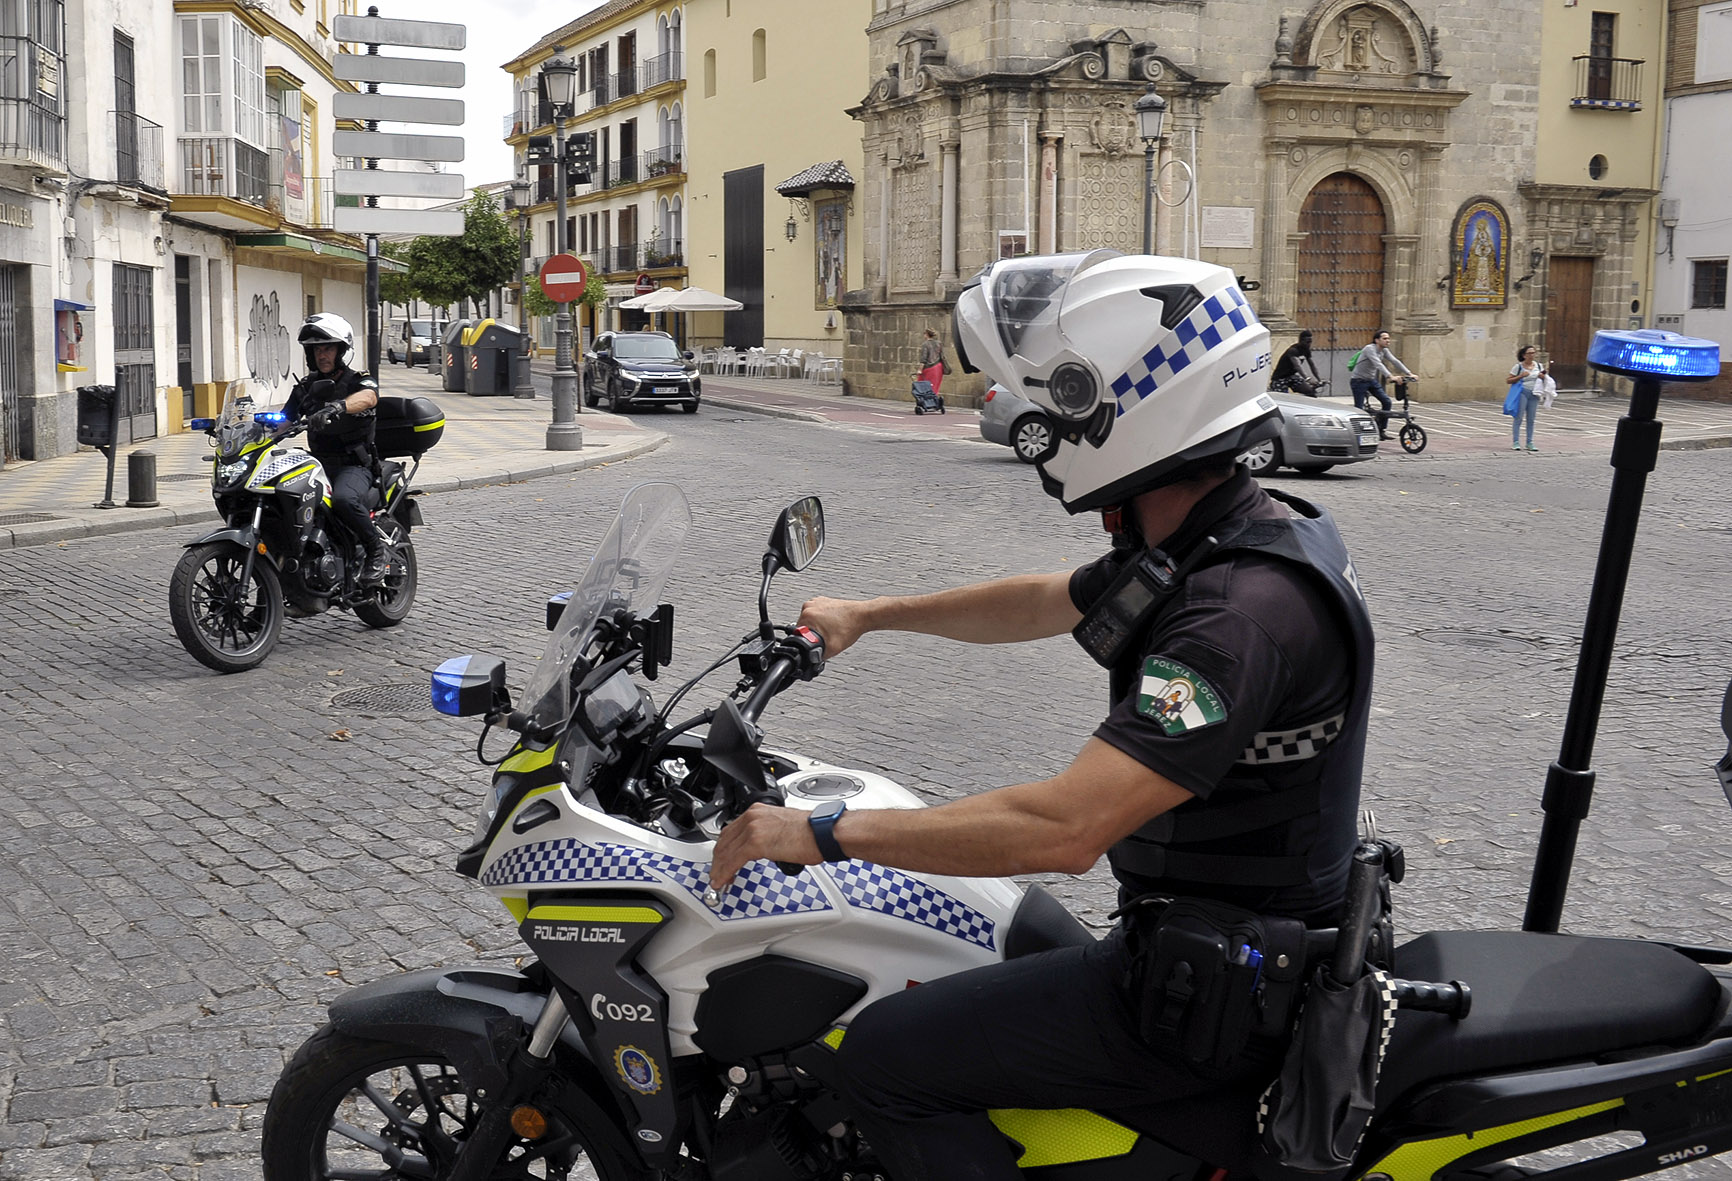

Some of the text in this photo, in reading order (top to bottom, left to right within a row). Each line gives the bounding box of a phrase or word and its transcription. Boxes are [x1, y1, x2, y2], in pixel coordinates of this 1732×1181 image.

[1222, 367, 1248, 388] PL
[1152, 659, 1220, 713] POLICIA LOCAL
[1144, 707, 1172, 729] JEREZ
[533, 925, 626, 943] POLICIA LOCAL
[606, 1003, 656, 1022] 092
[1657, 1145, 1709, 1165] SHAD
